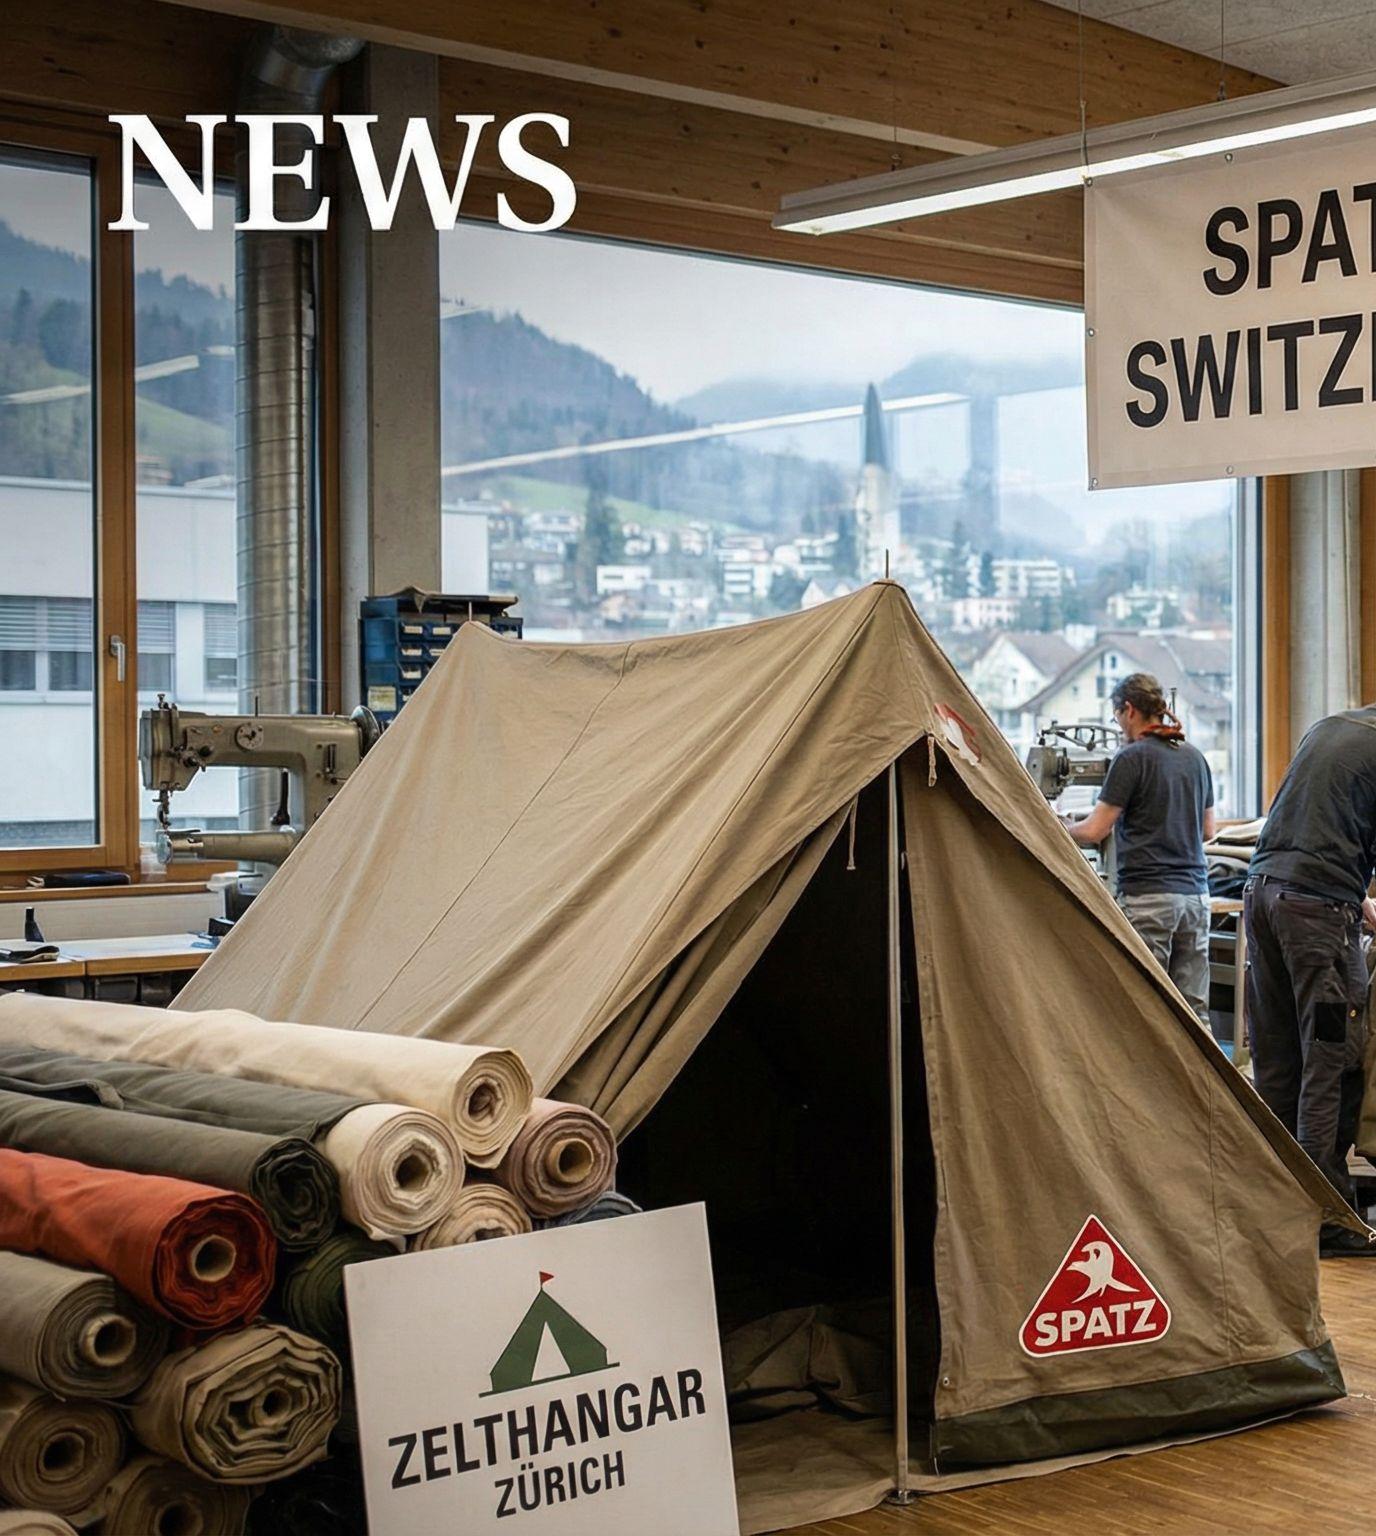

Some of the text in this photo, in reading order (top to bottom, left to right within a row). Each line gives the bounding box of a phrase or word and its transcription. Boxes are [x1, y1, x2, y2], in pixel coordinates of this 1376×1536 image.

[1034, 1298, 1157, 1347] SPATZ
[388, 1368, 706, 1490] ZELTHANGAR
[494, 1450, 626, 1519] ZÜRICH
